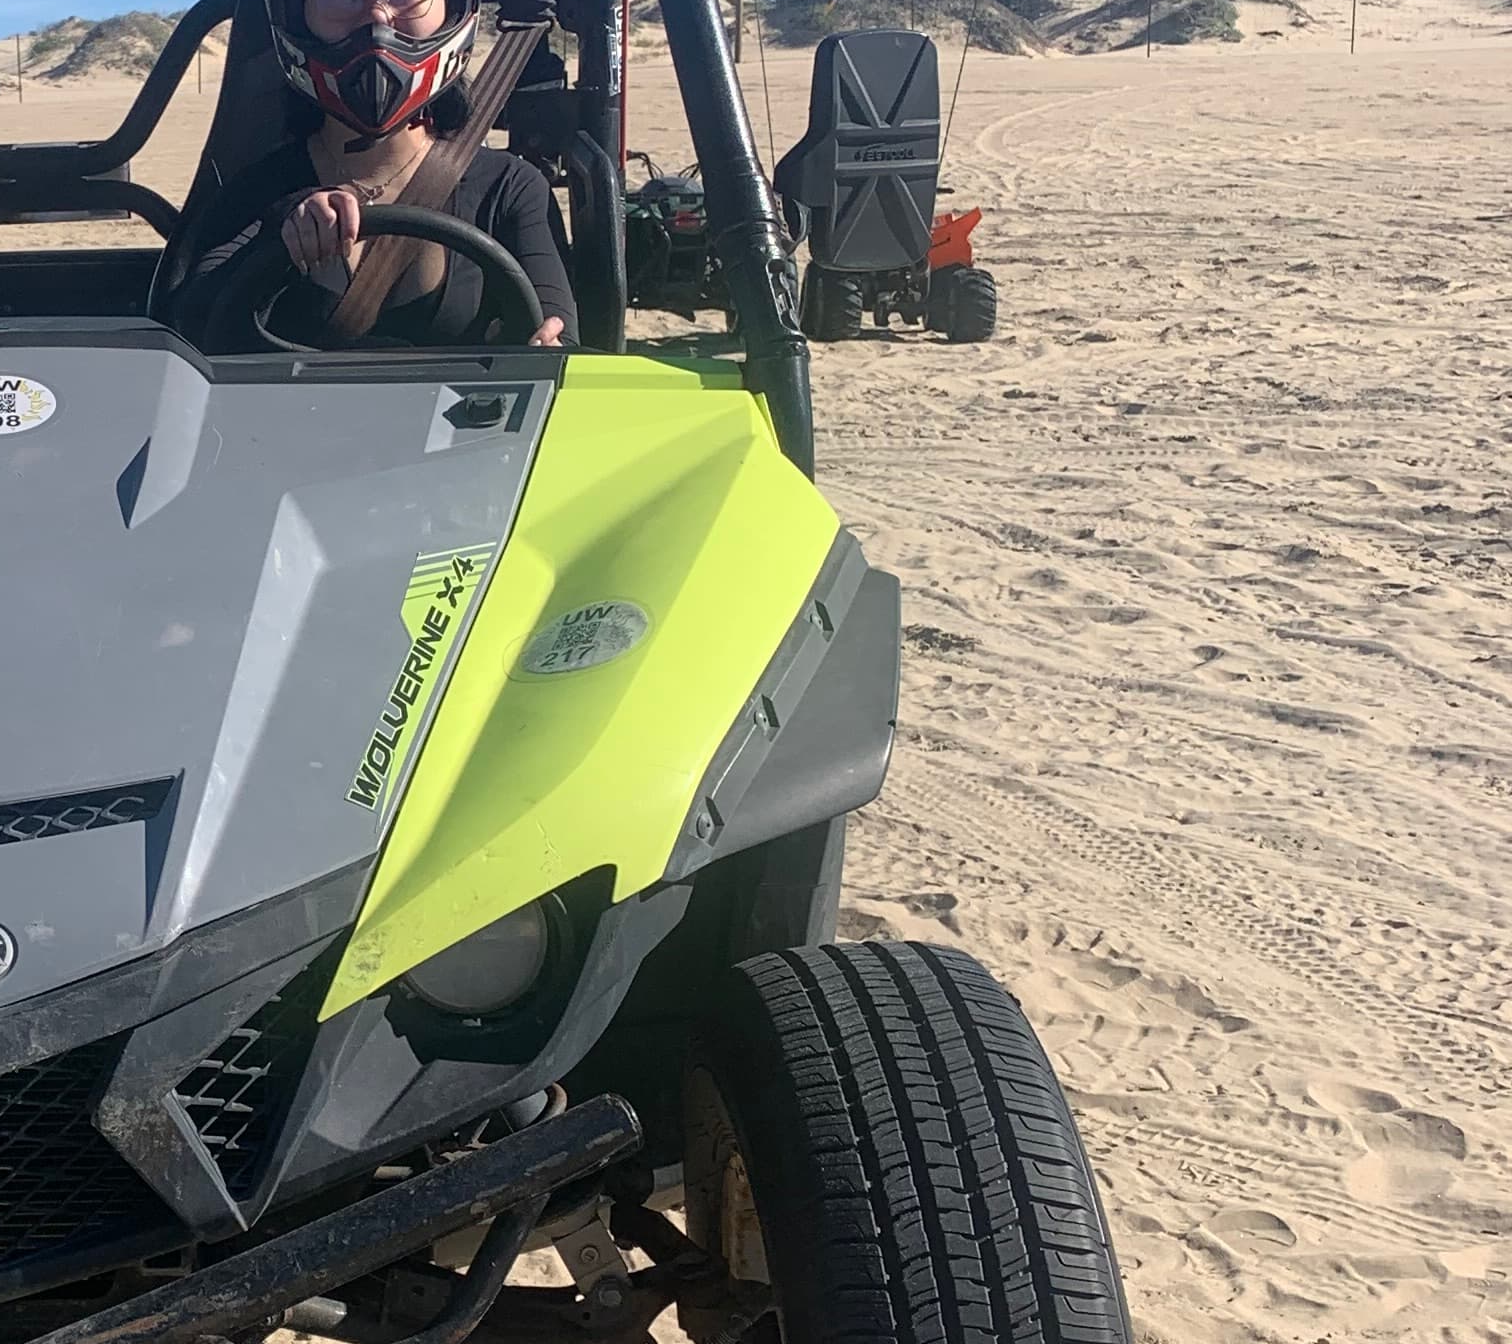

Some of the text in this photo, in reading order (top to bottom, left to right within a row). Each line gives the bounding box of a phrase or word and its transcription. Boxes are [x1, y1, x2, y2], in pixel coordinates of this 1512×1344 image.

[562, 605, 614, 626] UW
[540, 645, 595, 667] 217
[349, 555, 475, 808] WOLVERINE X4
